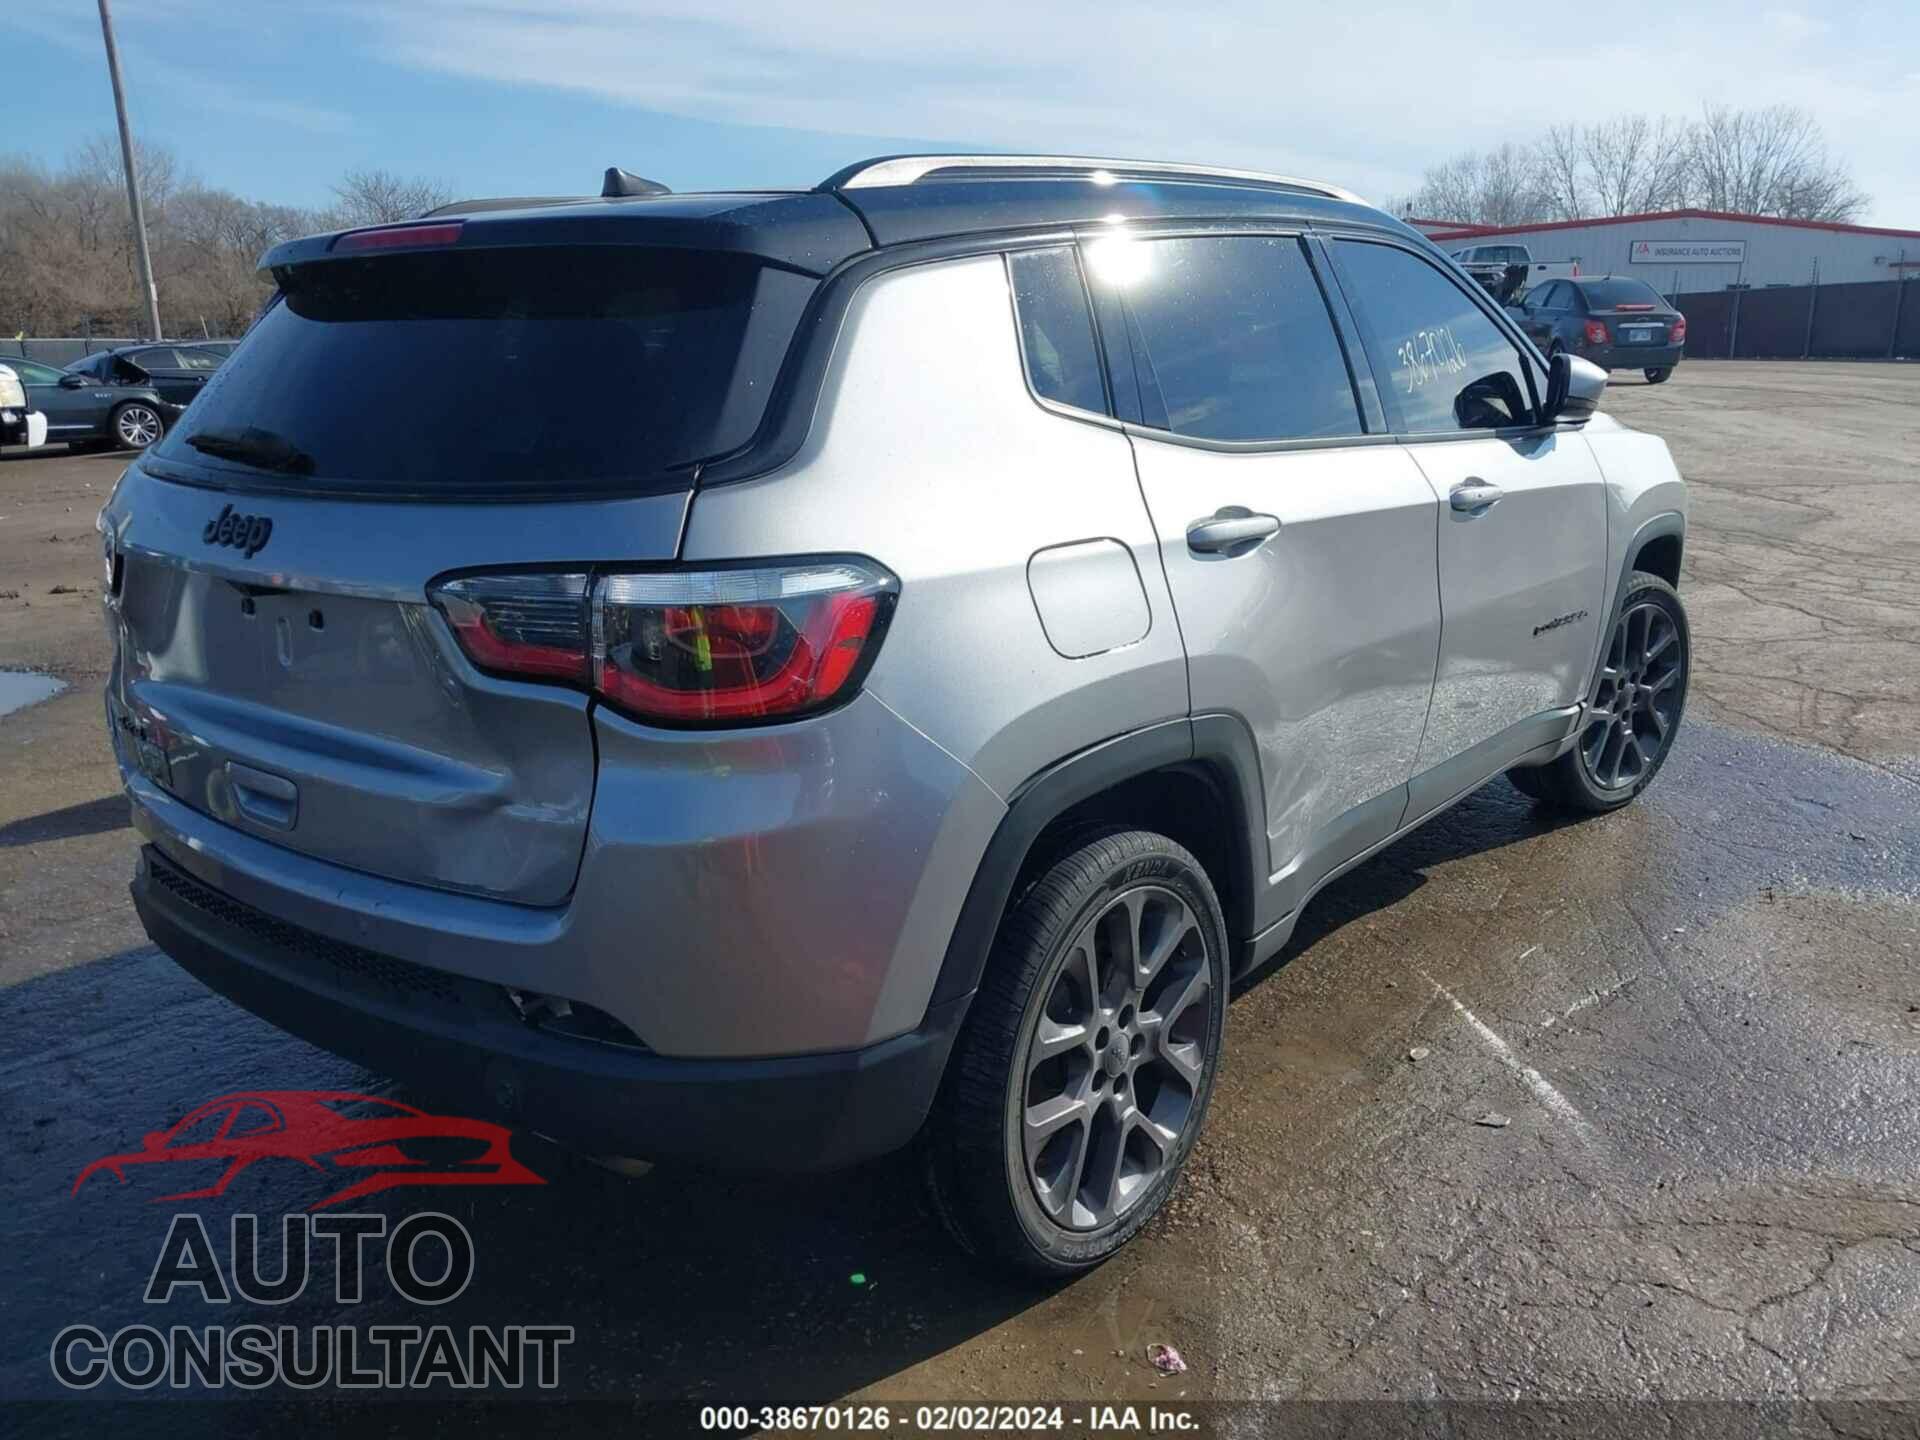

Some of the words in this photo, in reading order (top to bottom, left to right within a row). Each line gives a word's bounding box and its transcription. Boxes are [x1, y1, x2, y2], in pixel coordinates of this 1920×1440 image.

[1654, 247, 1690, 257] INSURANCE
[1691, 247, 1709, 257] AUTO
[1710, 247, 1741, 257] AUCTIONS
[202, 504, 272, 560] Jeep
